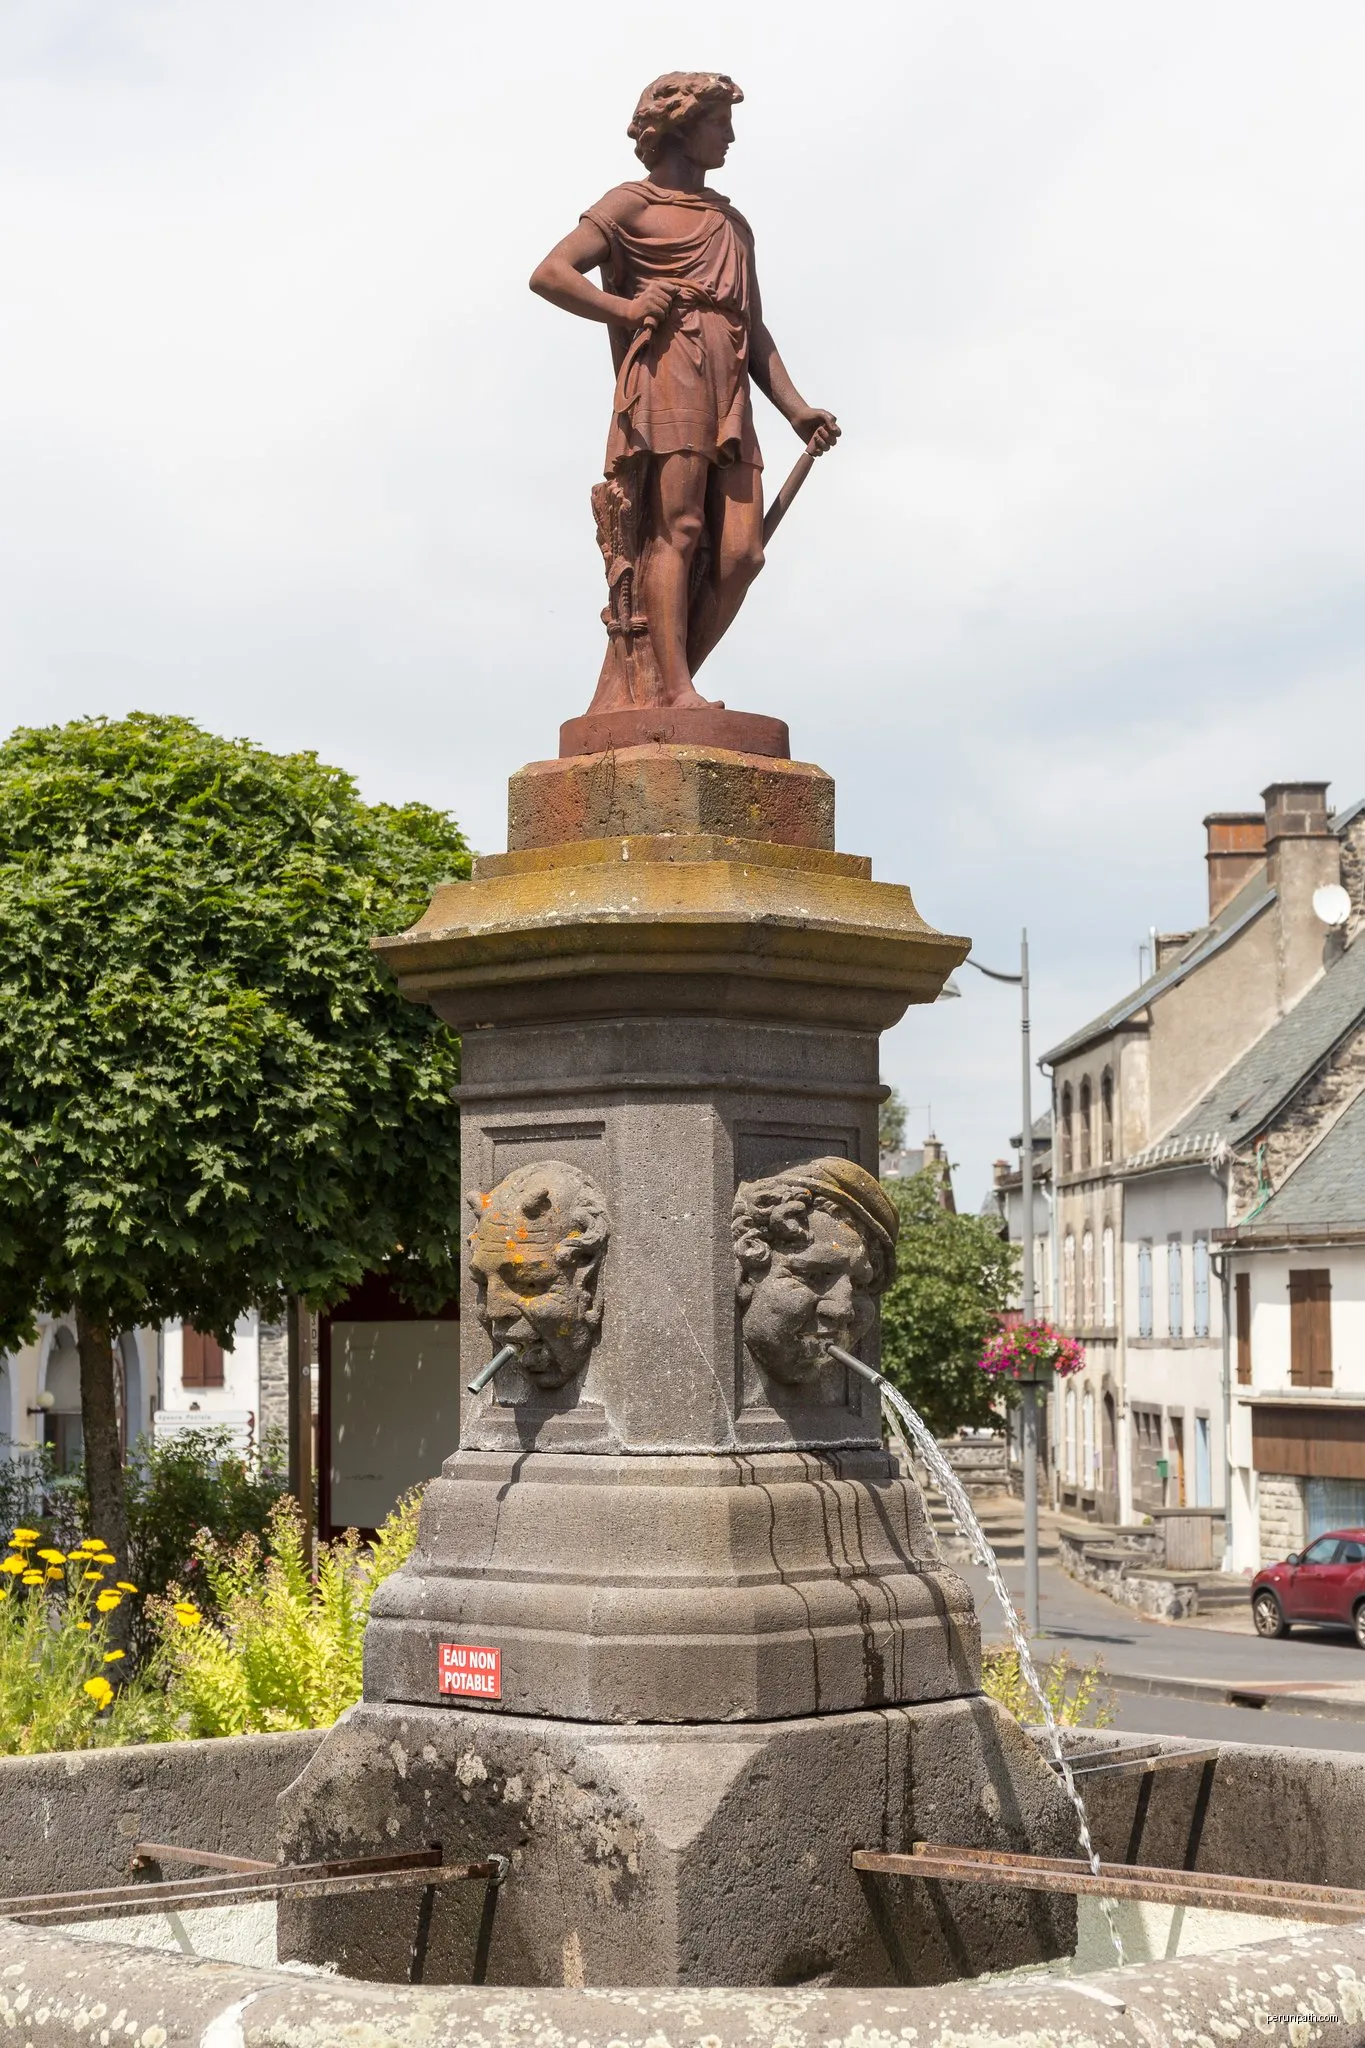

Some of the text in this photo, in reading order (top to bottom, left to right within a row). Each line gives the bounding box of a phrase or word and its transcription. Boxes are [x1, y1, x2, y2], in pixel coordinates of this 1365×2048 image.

[443, 1649, 496, 1670] EAU NON
[444, 1671, 495, 1692] POTABLE
